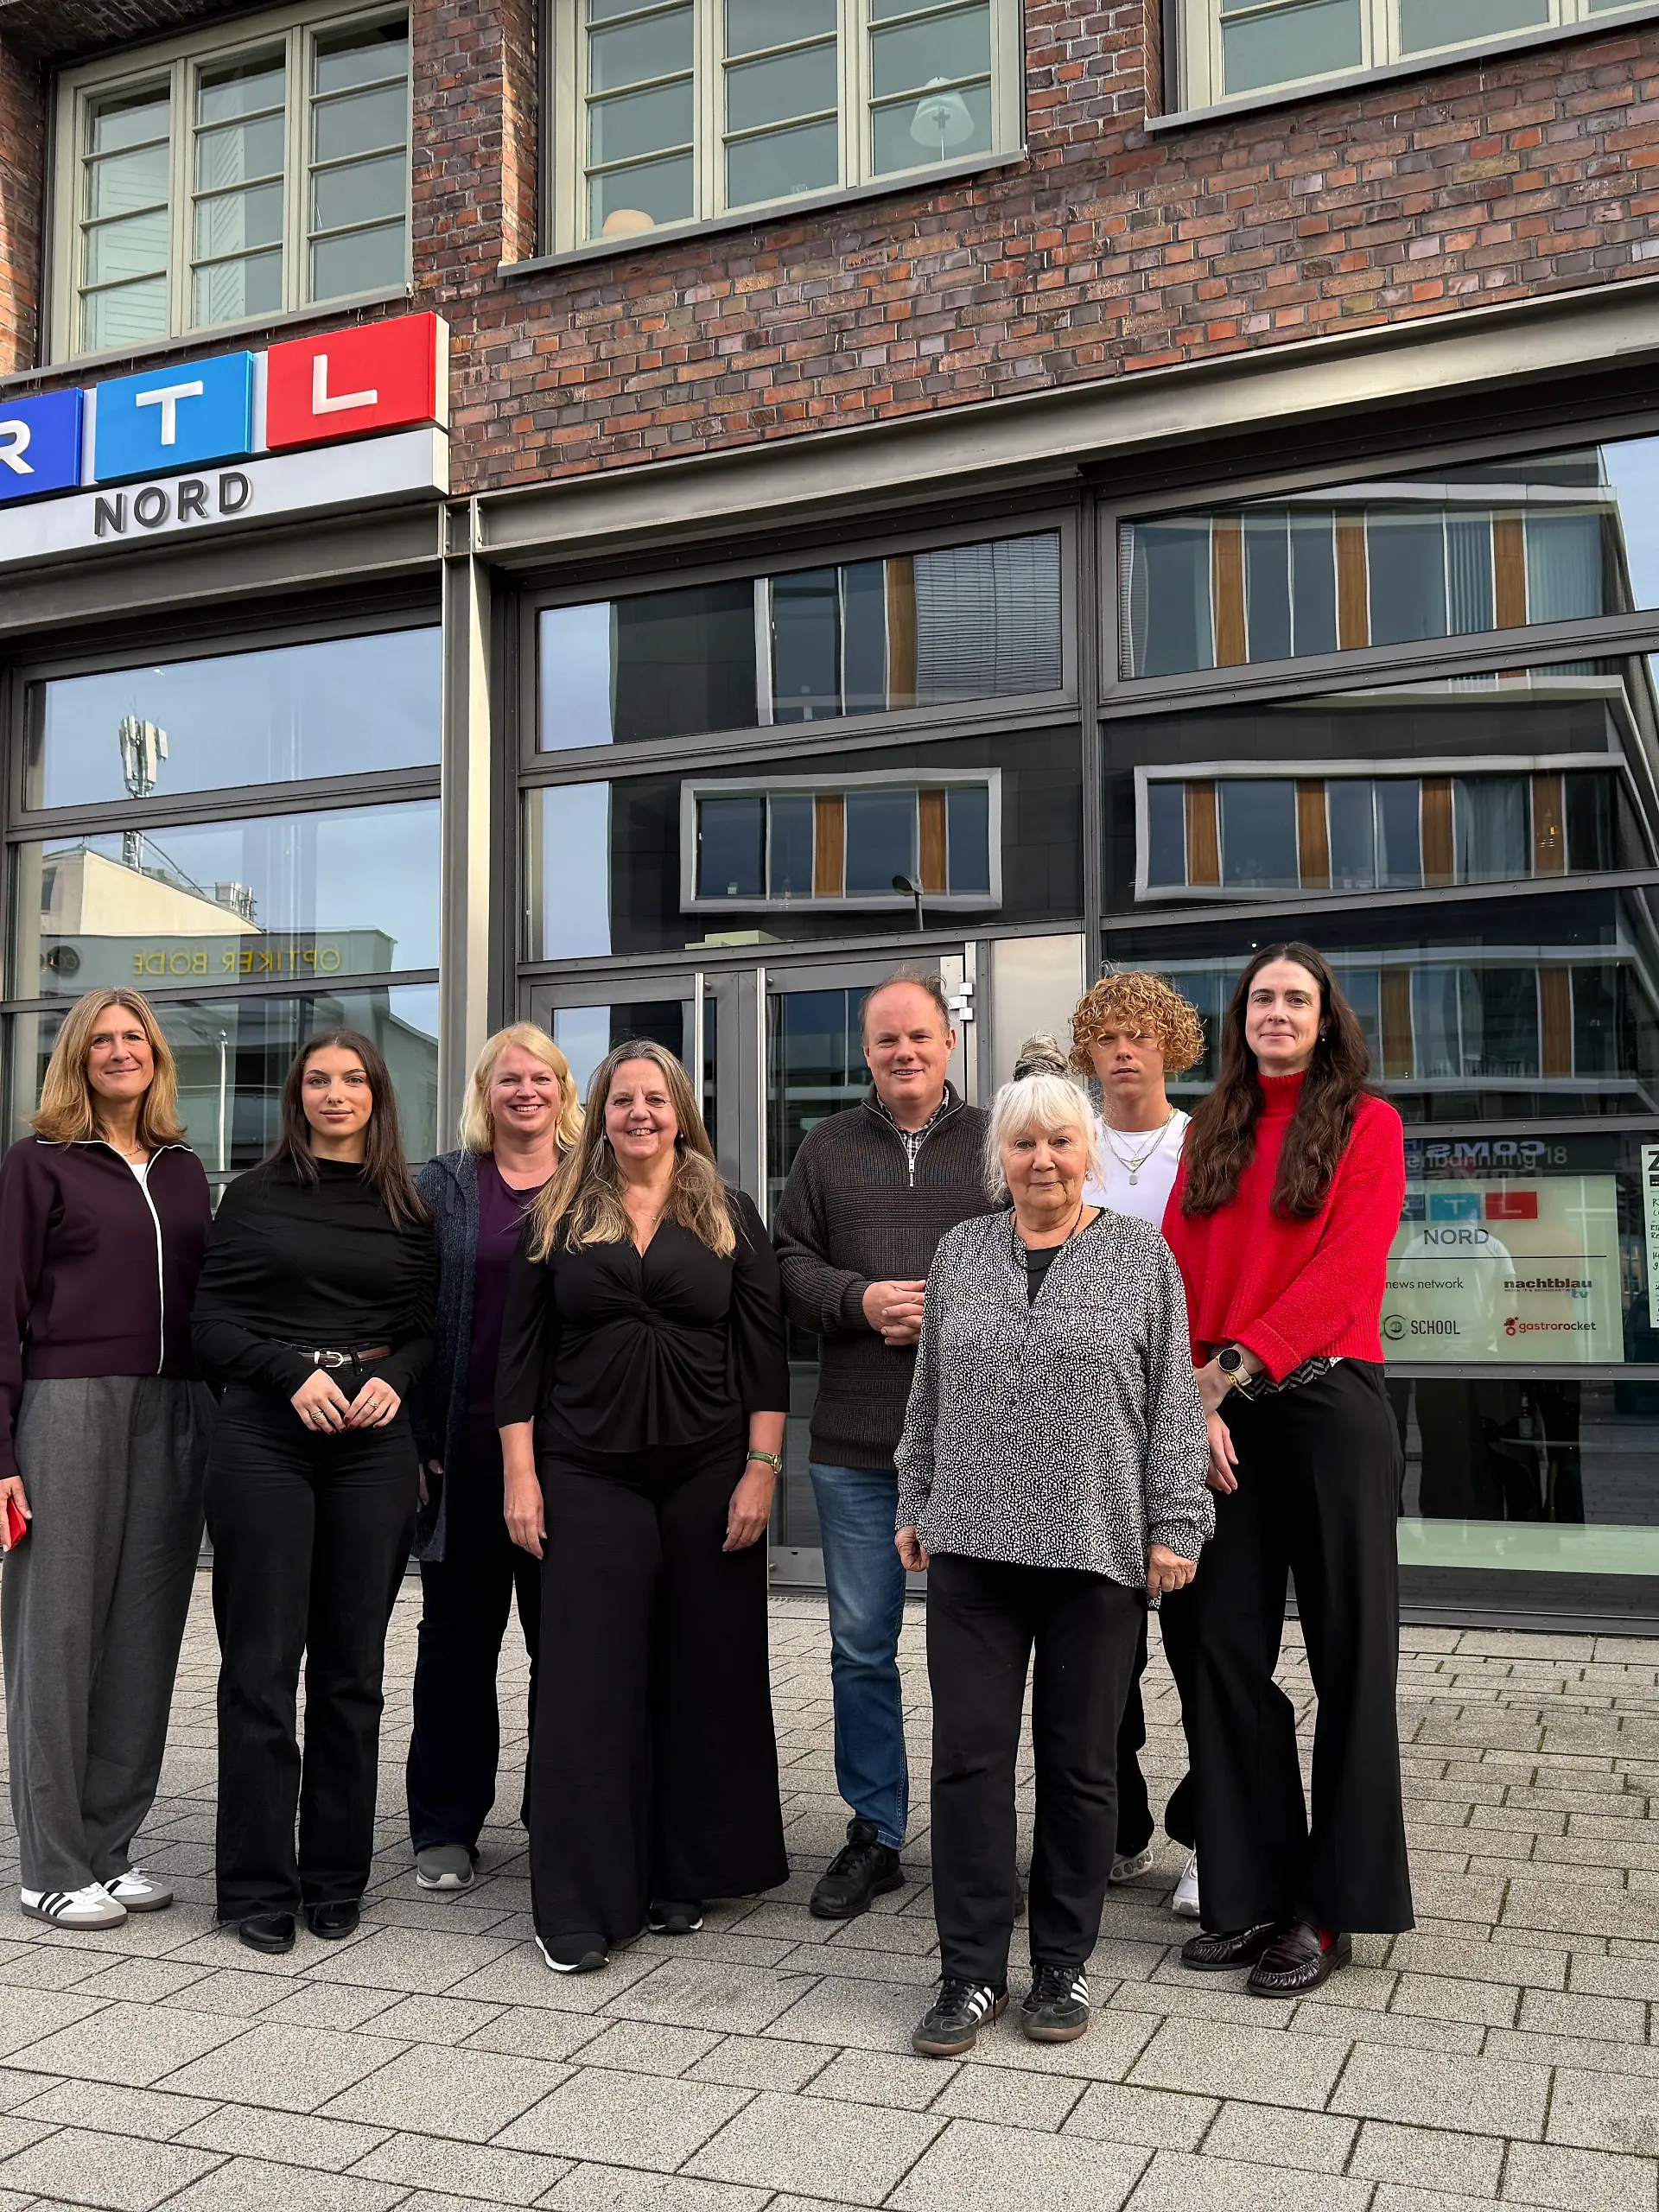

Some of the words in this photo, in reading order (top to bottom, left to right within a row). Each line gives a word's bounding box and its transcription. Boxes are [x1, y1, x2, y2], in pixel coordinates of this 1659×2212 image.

[93, 471, 252, 537] NORD
[1547, 1146, 1567, 1165] 18
[1424, 1229, 1489, 1245] NORD
[1417, 1276, 1464, 1289] network
[1503, 1278, 1592, 1288] nachtblau
[1571, 1289, 1589, 1299] tv
[1410, 1319, 1460, 1335] SCHOOL
[1518, 1320, 1597, 1333] gastrorocket
